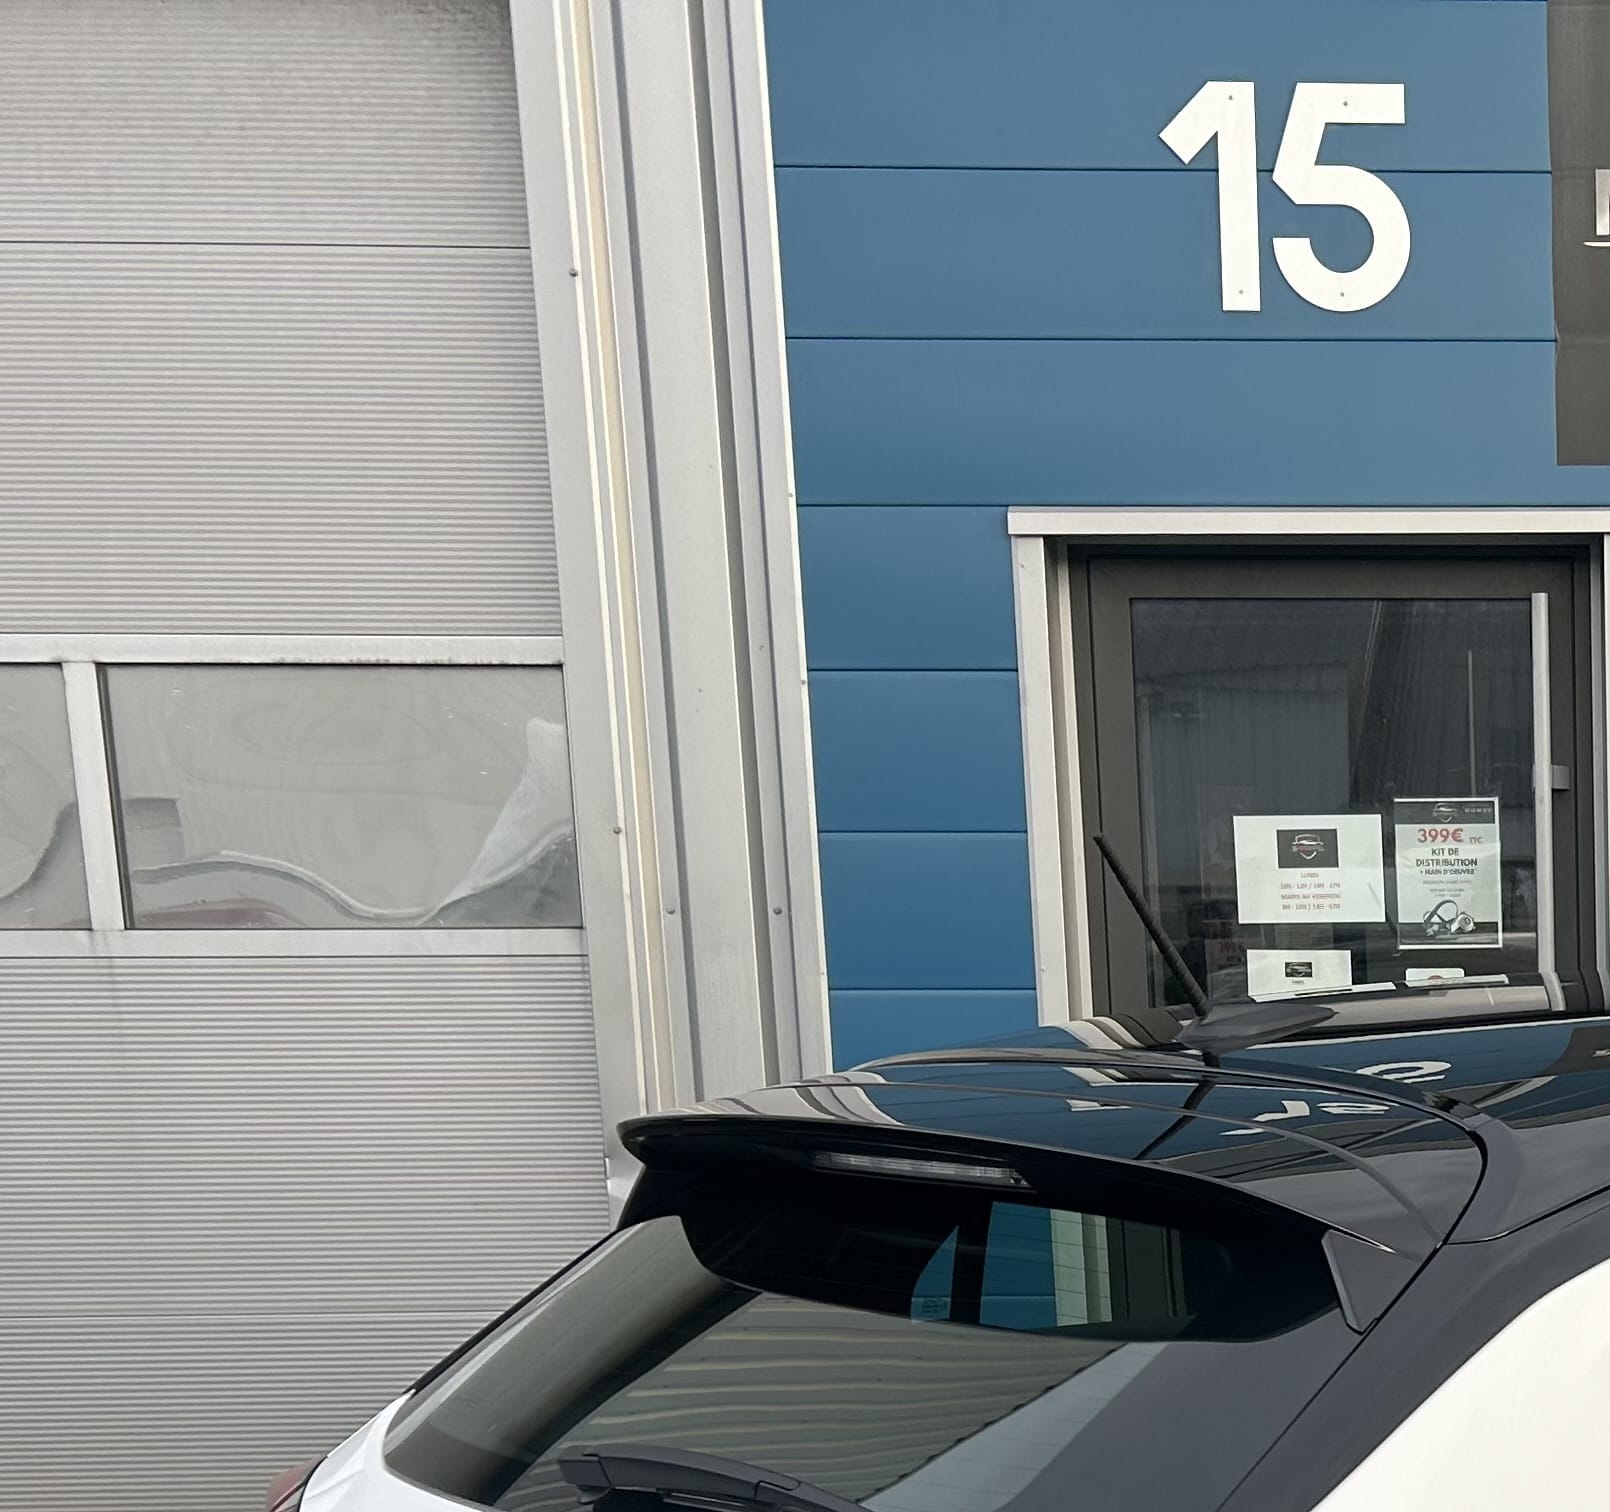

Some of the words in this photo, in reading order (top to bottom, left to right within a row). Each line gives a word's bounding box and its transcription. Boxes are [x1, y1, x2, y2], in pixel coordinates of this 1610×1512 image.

[1158, 80, 1412, 312] 15
[1417, 828, 1464, 843] 399€
[1431, 847, 1445, 856] KIT
[1447, 847, 1459, 856] DE
[1415, 858, 1478, 867] DISTRIBUTION
